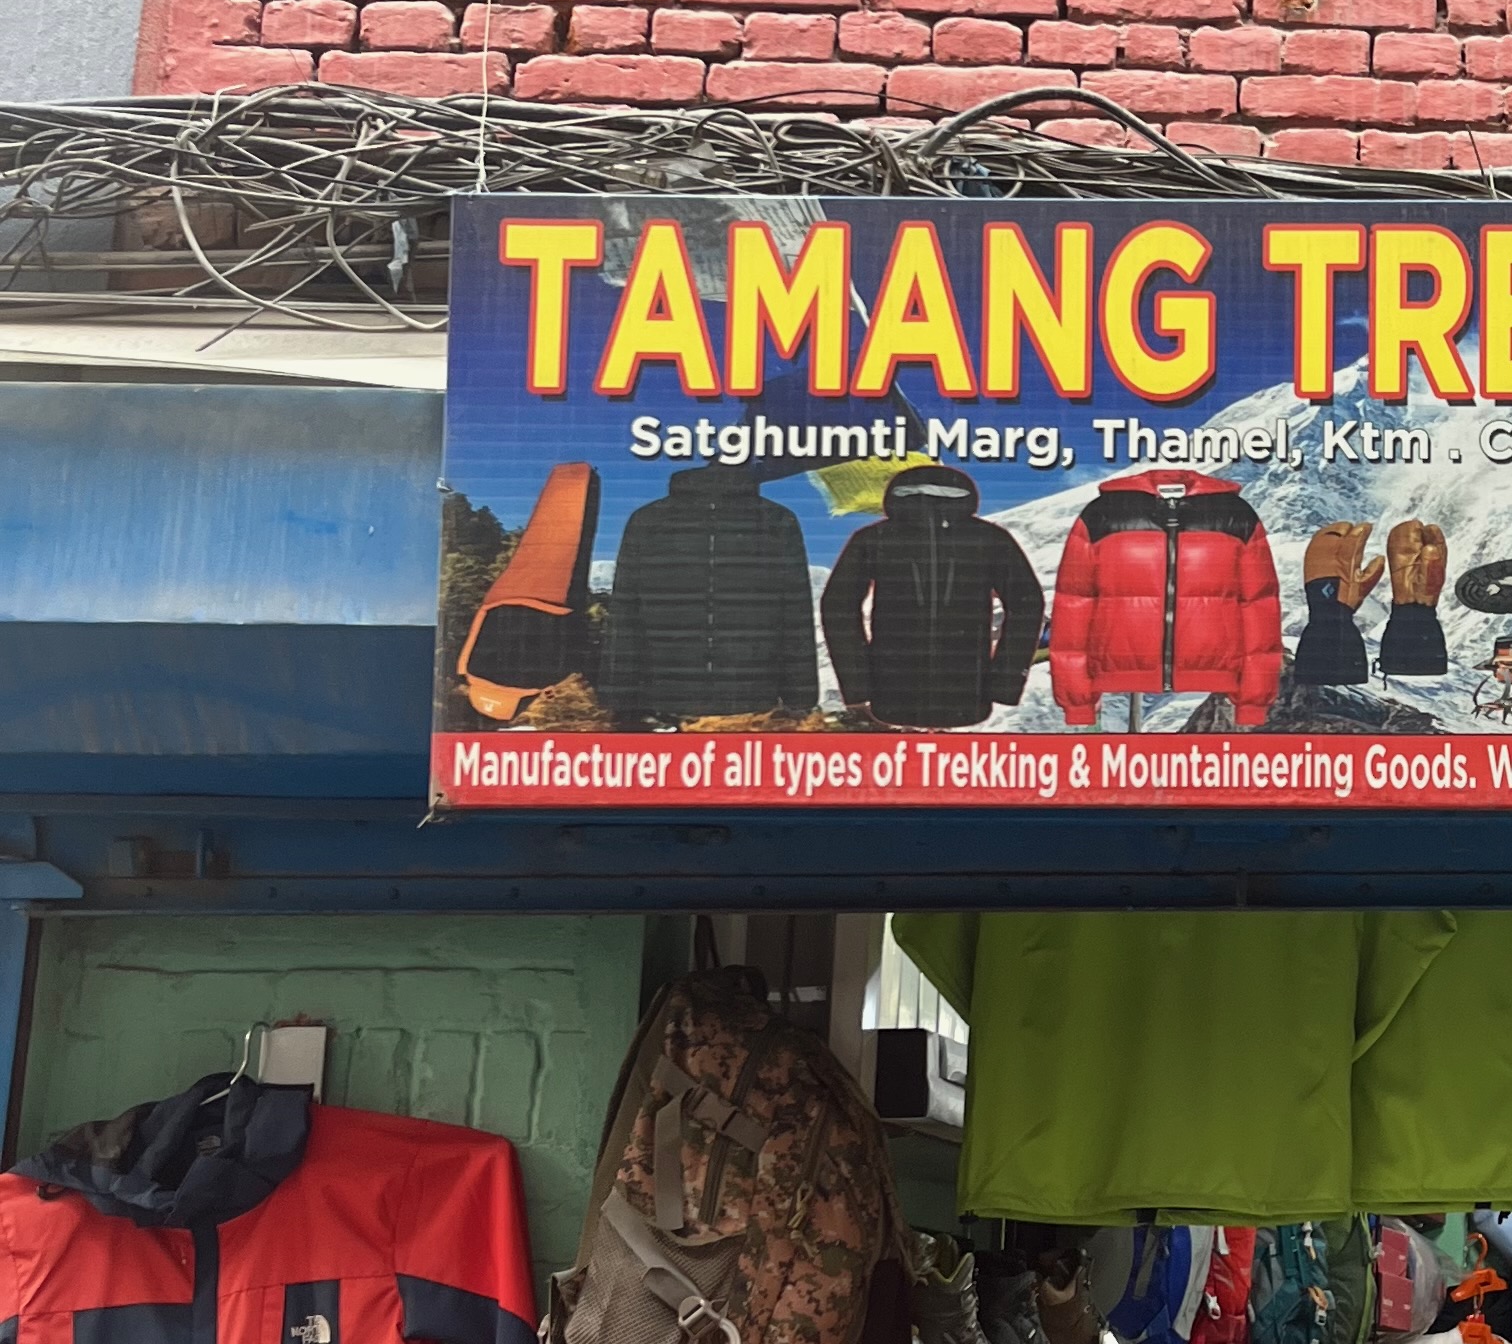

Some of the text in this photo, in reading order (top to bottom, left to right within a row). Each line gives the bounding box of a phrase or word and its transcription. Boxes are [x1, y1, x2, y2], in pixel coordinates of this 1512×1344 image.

[498, 218, 1217, 402] TAMANG
[630, 415, 905, 465] Satghumti
[926, 418, 1073, 467] Marg,
[1093, 418, 1303, 467] Thamel,
[1322, 420, 1430, 462] Ktm
[454, 740, 671, 788] Manufacturer
[681, 741, 716, 787] of
[724, 741, 761, 786] all
[773, 744, 862, 797] types
[873, 741, 906, 787] of
[917, 742, 1058, 798] Trekking
[1069, 744, 1090, 788] &
[1102, 742, 1353, 798] Mountaineering
[1365, 743, 1476, 789] Goods.
